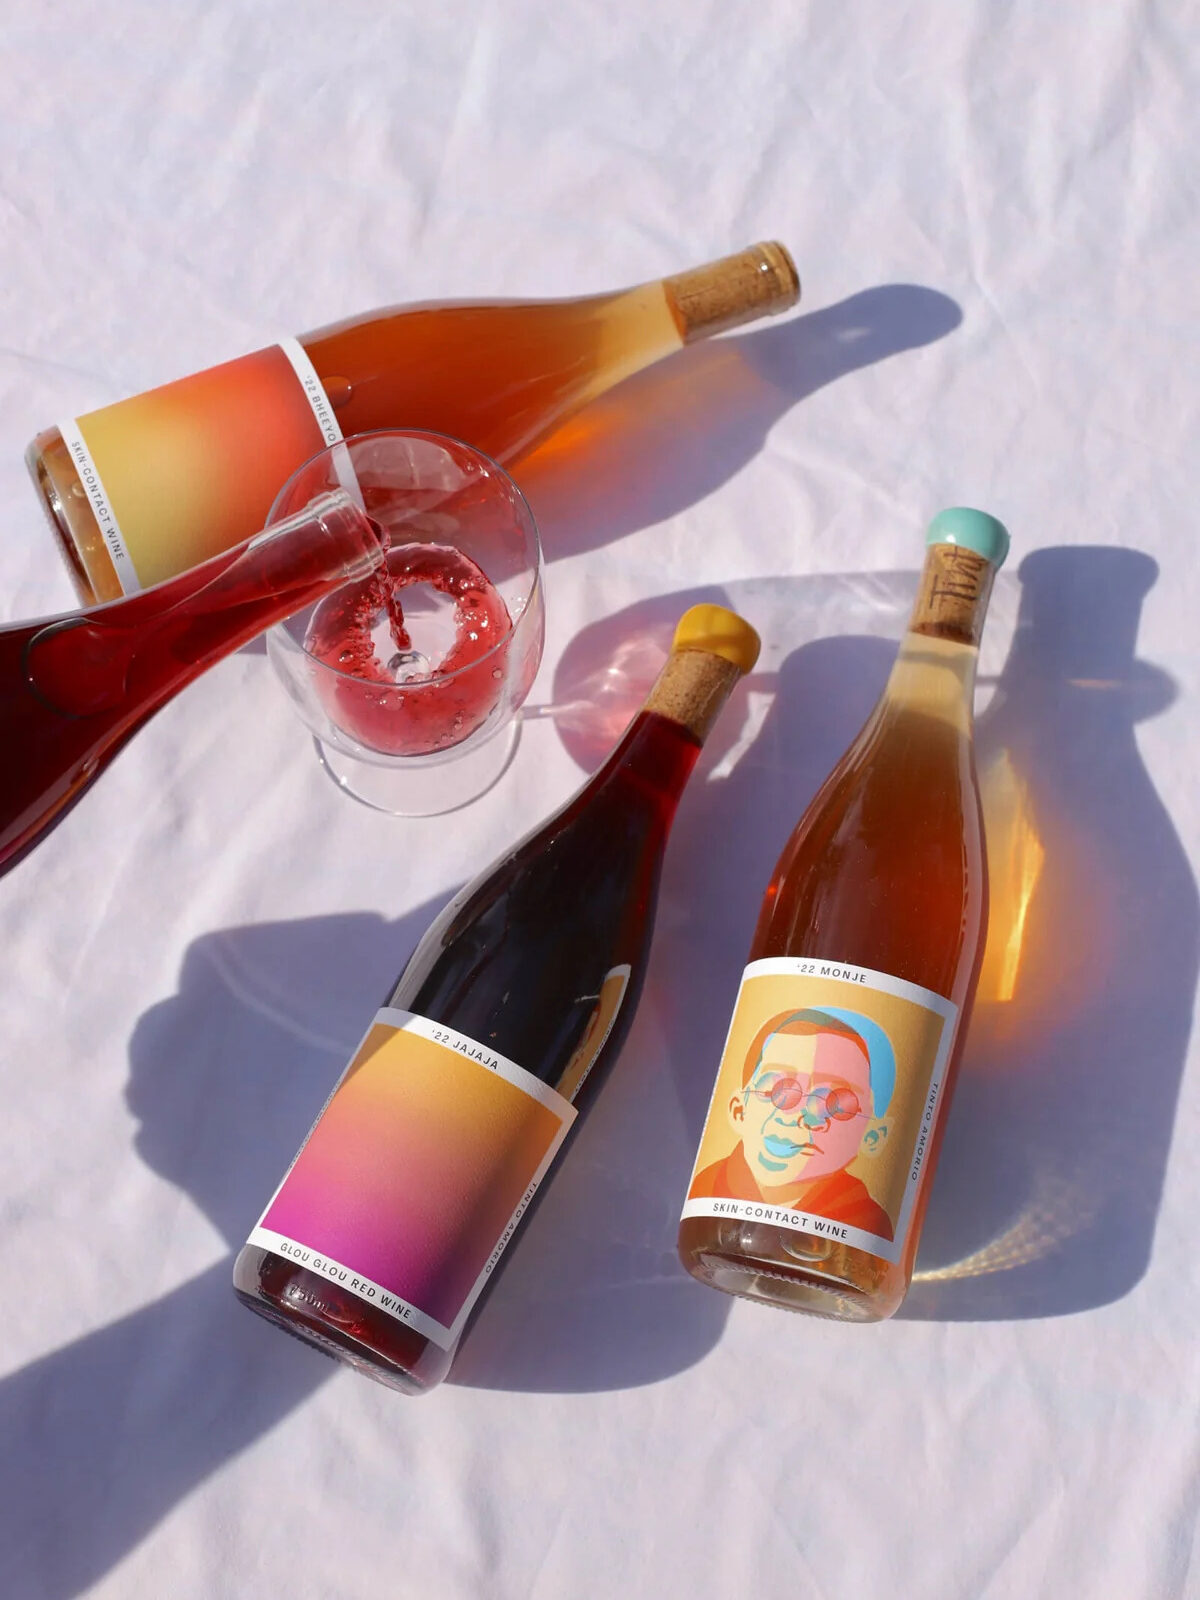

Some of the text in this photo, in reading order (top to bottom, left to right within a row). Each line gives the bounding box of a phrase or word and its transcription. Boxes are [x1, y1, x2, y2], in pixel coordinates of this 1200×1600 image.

[312, 395, 336, 442] BHEEYO
[71, 441, 125, 560] SKIN-CONTACT WINE
[820, 966, 867, 983] MONJE
[432, 1028, 499, 1070] '22 JAJAJA
[911, 1083, 938, 1181] TINTO AMORIO
[485, 1182, 538, 1274] TINTO AMORIO
[712, 1202, 848, 1239] SKIN-CONTACT WINE
[280, 1242, 412, 1319] GLOU GLOU RED WINE
